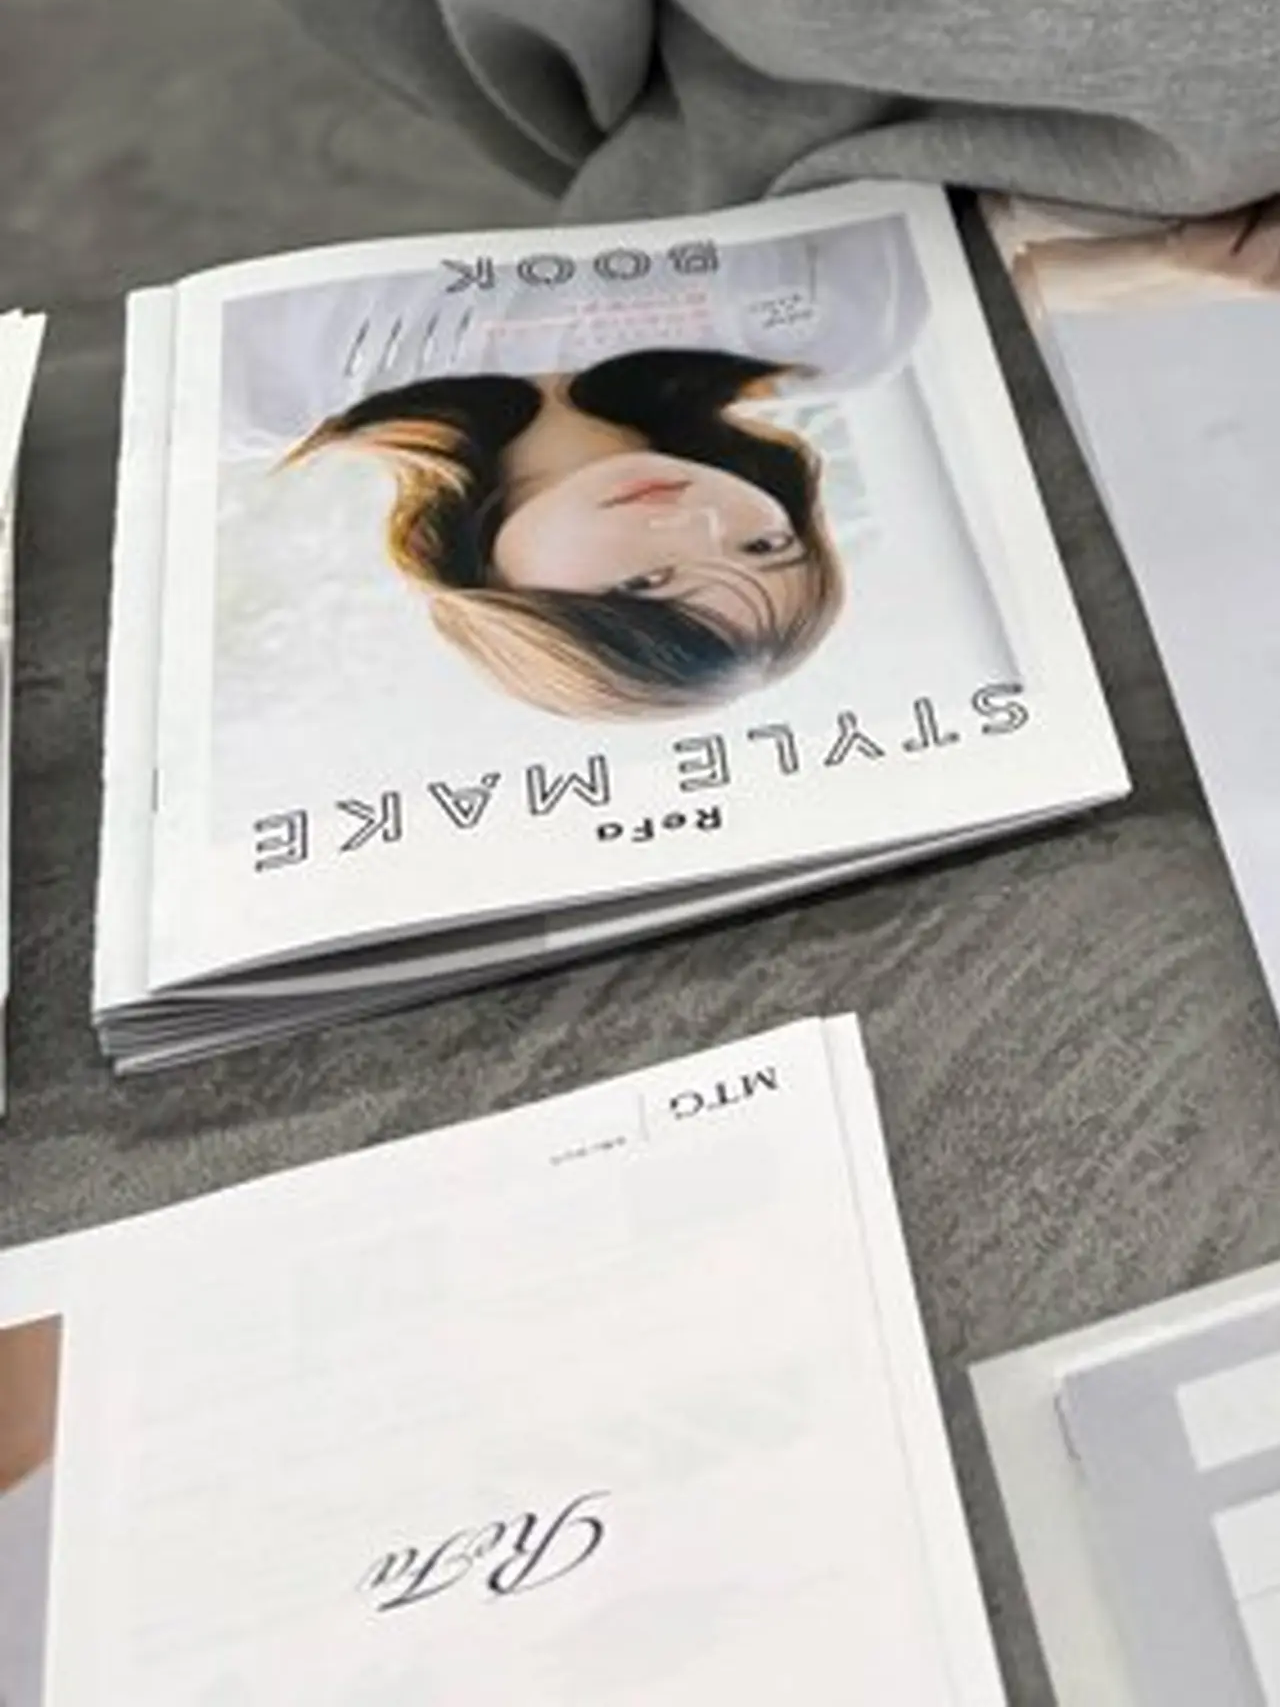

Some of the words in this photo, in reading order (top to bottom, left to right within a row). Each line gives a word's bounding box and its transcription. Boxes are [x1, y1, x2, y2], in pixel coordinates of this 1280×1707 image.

[442, 239, 718, 293] BOOK
[671, 680, 1029, 792] STYLE
[251, 754, 612, 872] MAKE
[592, 804, 722, 844] ReFa
[670, 1068, 777, 1119] MTG
[352, 1491, 611, 1614] ReFa
